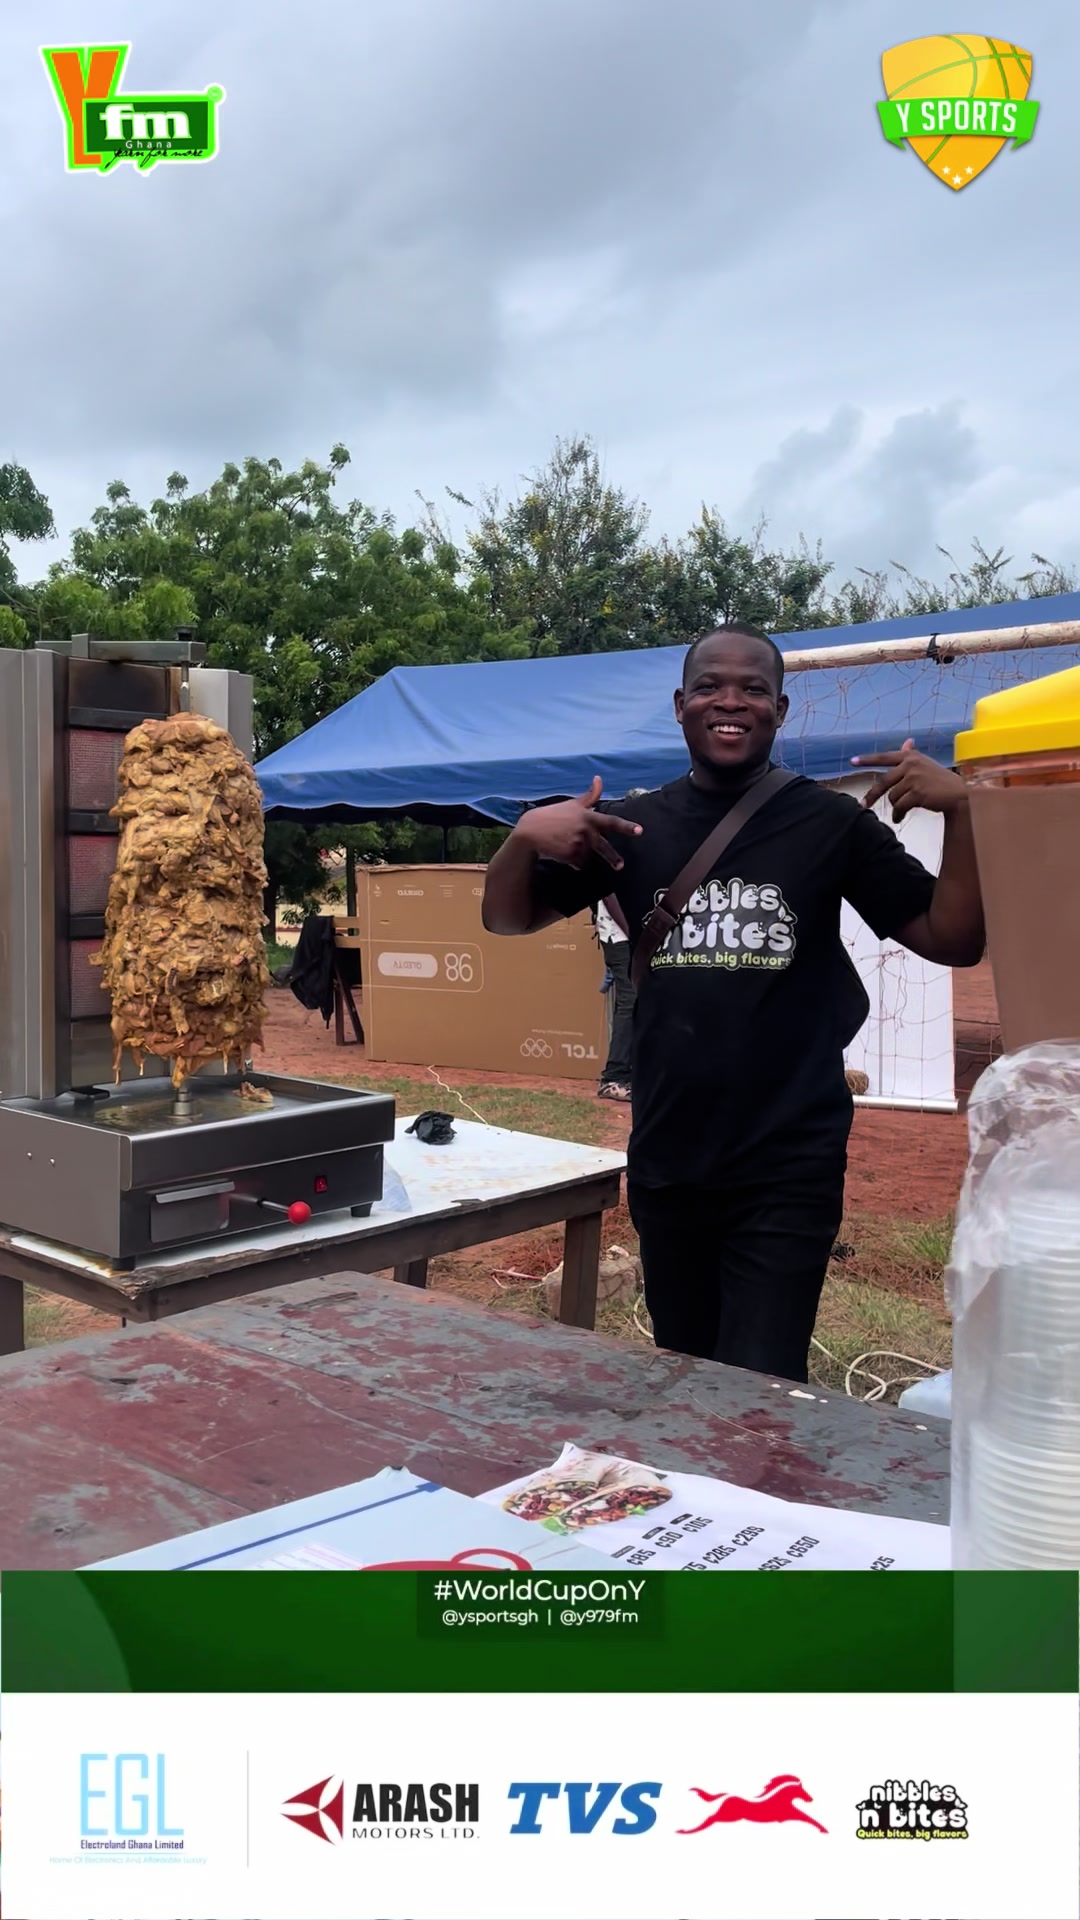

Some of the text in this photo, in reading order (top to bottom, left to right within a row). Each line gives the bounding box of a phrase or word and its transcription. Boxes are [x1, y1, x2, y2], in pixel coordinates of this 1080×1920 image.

[660, 881, 780, 914] bbles
[682, 912, 792, 951] bites
[444, 953, 474, 983] 98
[676, 952, 712, 965] bites,
[715, 952, 738, 967] big
[741, 952, 792, 967] flavors
[561, 1043, 599, 1059] TCL
